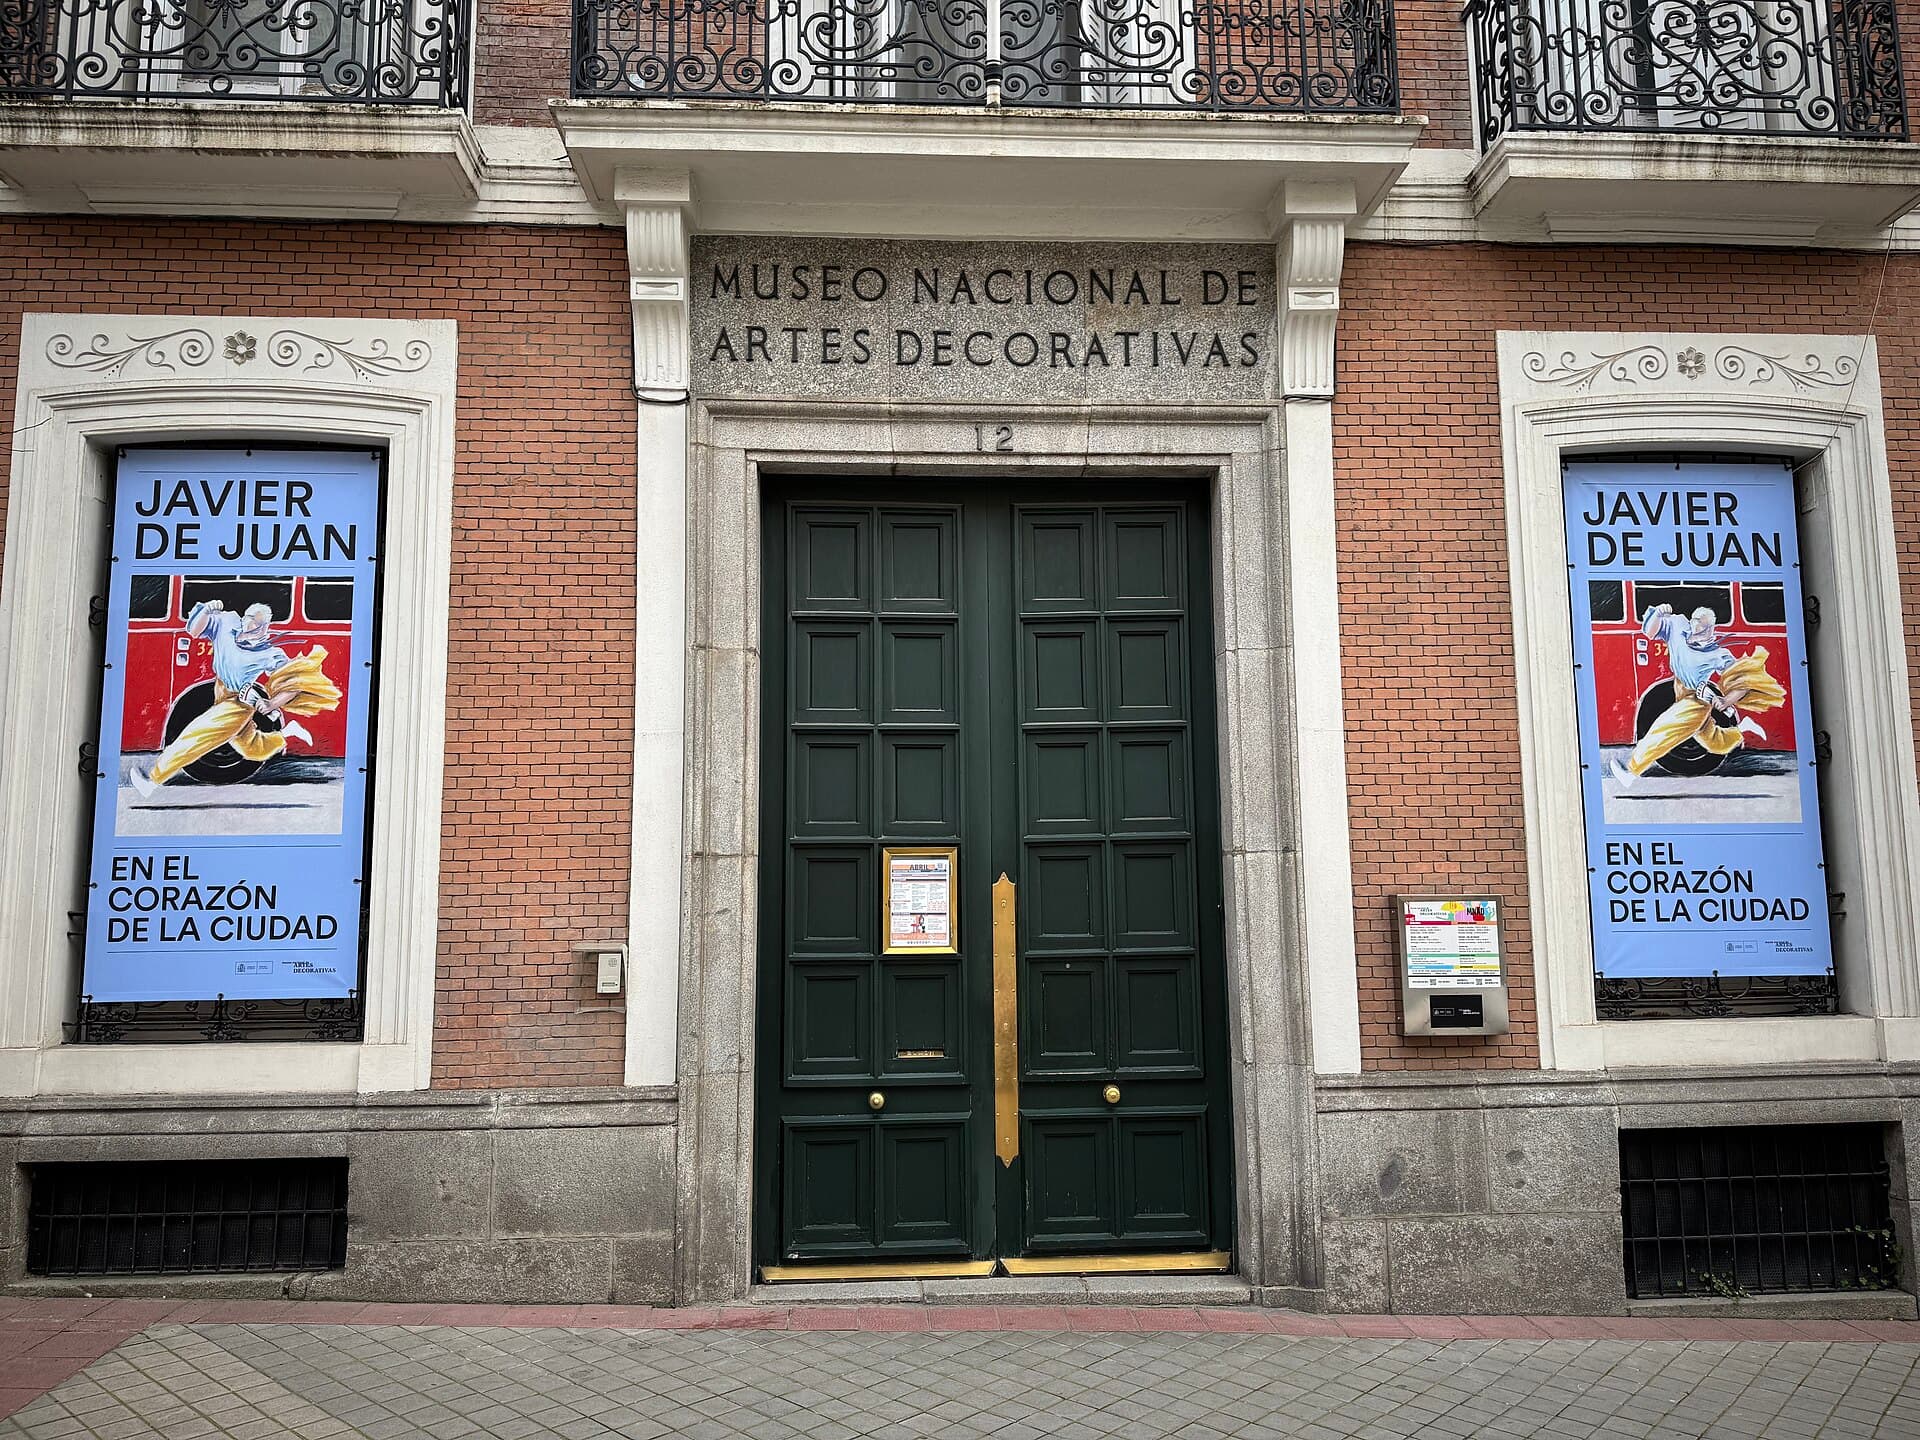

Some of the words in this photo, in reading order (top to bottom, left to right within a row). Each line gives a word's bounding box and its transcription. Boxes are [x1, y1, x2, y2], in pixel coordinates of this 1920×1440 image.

[710, 264, 888, 304] MUSEO
[914, 267, 1182, 306] NACIONAL
[1201, 269, 1258, 306] DE
[709, 325, 871, 364] ARTES
[896, 330, 1261, 369] DECORATIVAS
[974, 422, 1014, 452] 12
[135, 479, 313, 518] JAVIER
[1583, 491, 1739, 526] JAVIER
[135, 522, 201, 560] DE
[218, 523, 357, 561] JUAN
[1587, 531, 1645, 567] DE
[1661, 531, 1783, 567] JUAN
[111, 856, 154, 881] EN
[163, 855, 200, 881] EL
[1605, 842, 1643, 866] EN
[1651, 842, 1684, 866] EL
[108, 879, 277, 913] CORAZÓN
[1607, 865, 1754, 895] CORAZÓN
[1609, 899, 1647, 923] DE
[1654, 899, 1692, 923] LA
[1698, 897, 1810, 923] CIUDAD
[107, 917, 150, 943] DE
[159, 916, 201, 942] LA
[210, 915, 338, 942] CIUDAD
